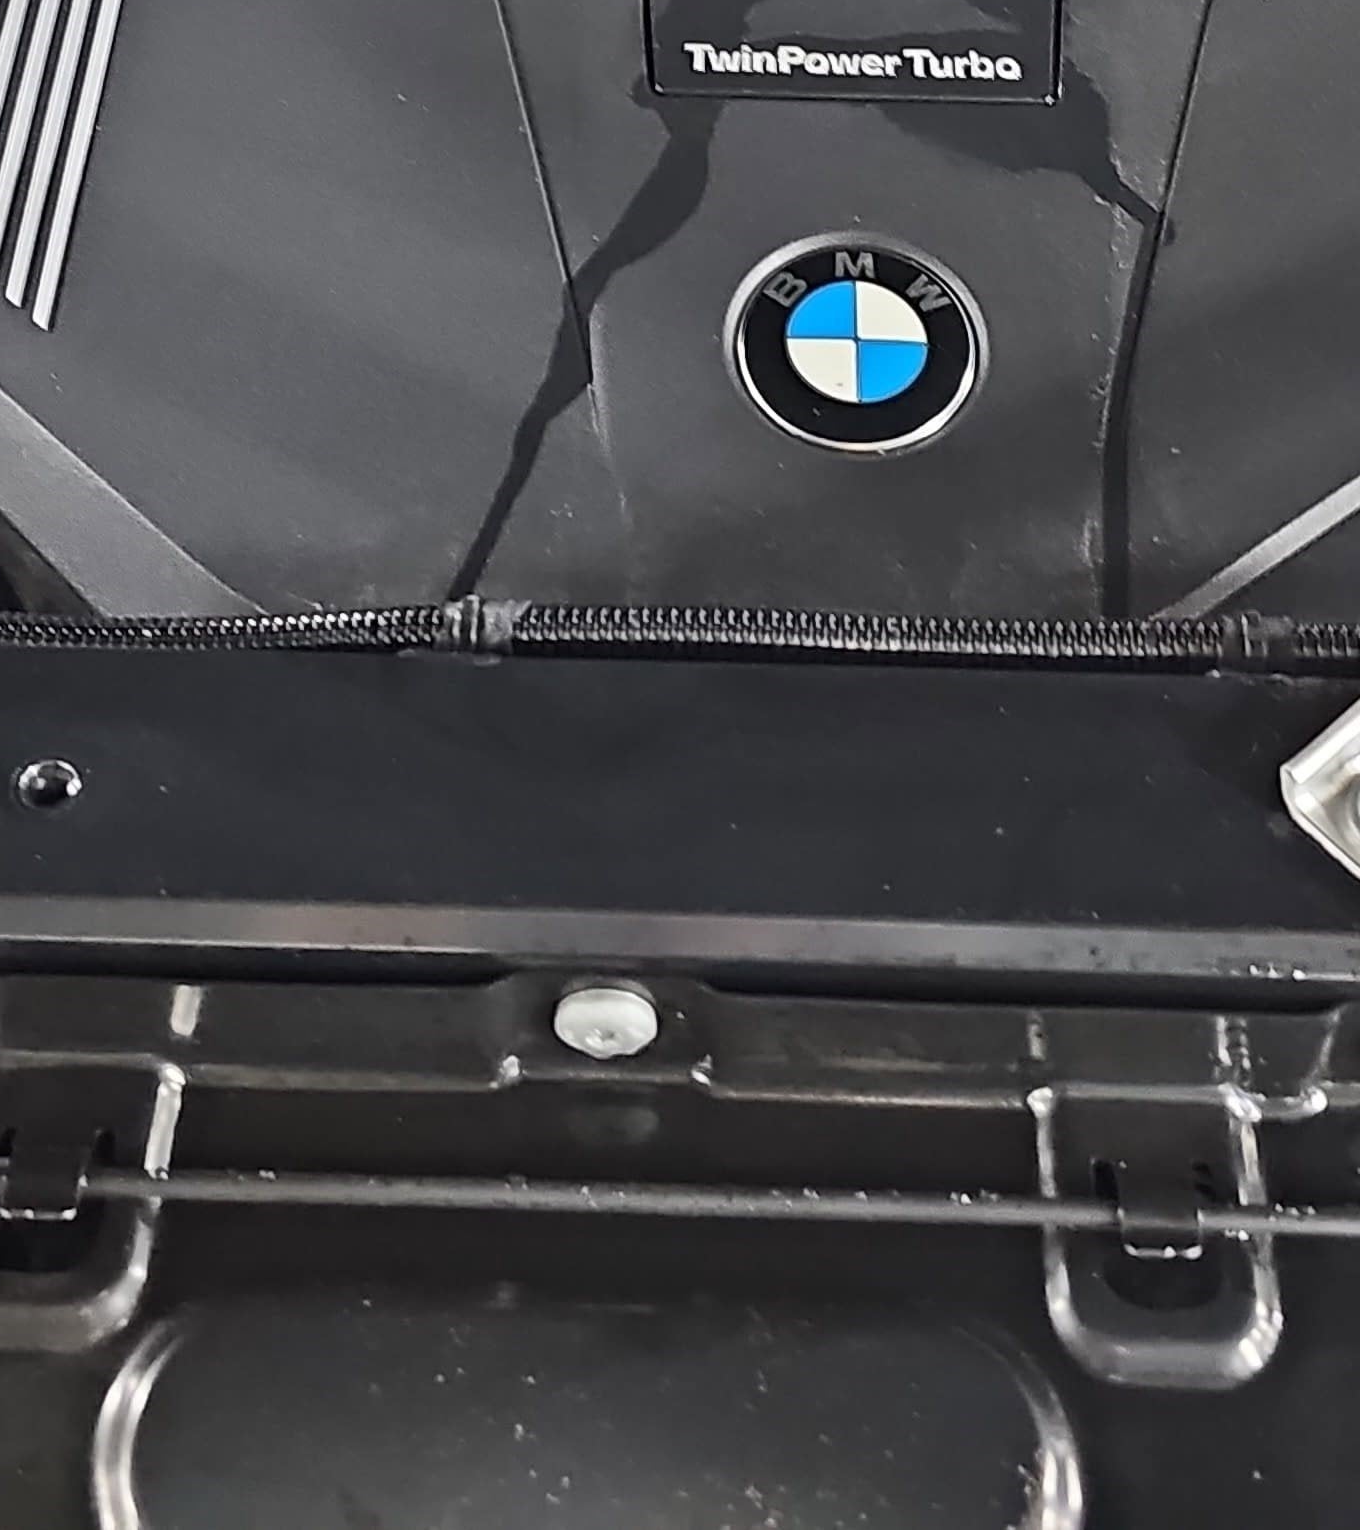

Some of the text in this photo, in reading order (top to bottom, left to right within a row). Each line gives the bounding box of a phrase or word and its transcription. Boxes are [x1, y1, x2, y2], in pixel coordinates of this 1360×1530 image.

[683, 42, 1023, 81] TwinPower Turbo
[763, 250, 952, 313] BMW
